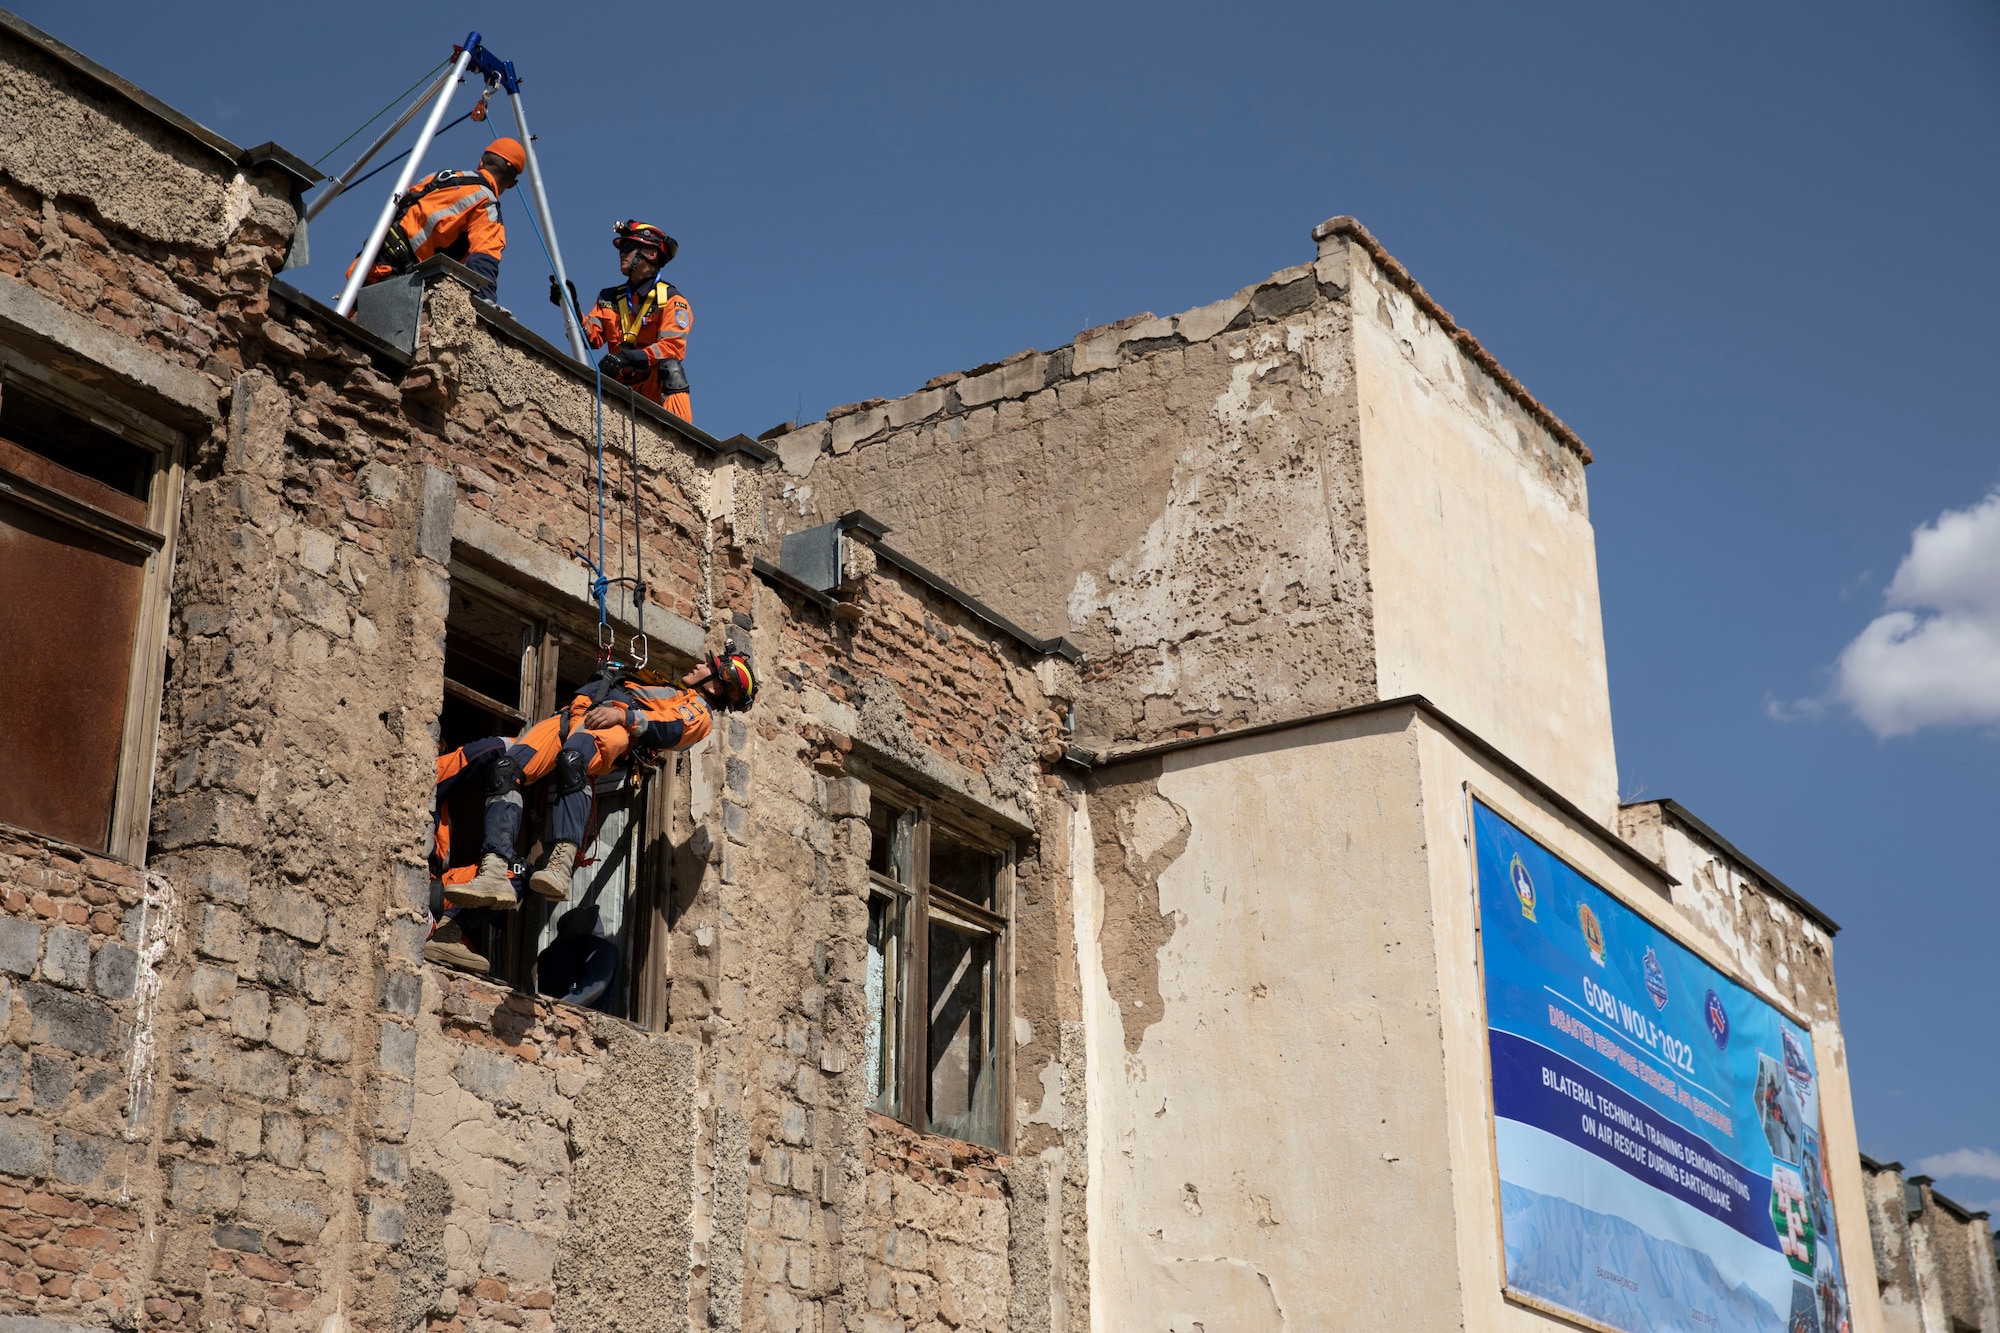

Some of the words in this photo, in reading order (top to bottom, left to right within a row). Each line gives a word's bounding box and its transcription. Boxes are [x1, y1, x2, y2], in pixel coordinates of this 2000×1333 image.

[1548, 1004, 1596, 1050] DISASTER
[1595, 1031, 1640, 1078] RESPONSE
[1638, 1060, 1678, 1102] EXERCISE
[1692, 1096, 1733, 1138] EXCHANGE
[1583, 976, 1619, 1024] GOBI
[1619, 1000, 1658, 1049] WOLF
[1658, 1029, 1695, 1074] 2022
[1541, 1066, 1597, 1111] BILATERAL
[1597, 1094, 1646, 1139] TECHNICAL
[1645, 1123, 1685, 1161] TRAINING
[1684, 1146, 1751, 1201] DEMONSTRATIONS
[1582, 1114, 1597, 1137] ON
[1598, 1122, 1613, 1147] AIR
[1614, 1131, 1647, 1166] RESCUE
[1648, 1150, 1680, 1183] DURING
[1679, 1168, 1732, 1212] EARTHQUAKE
